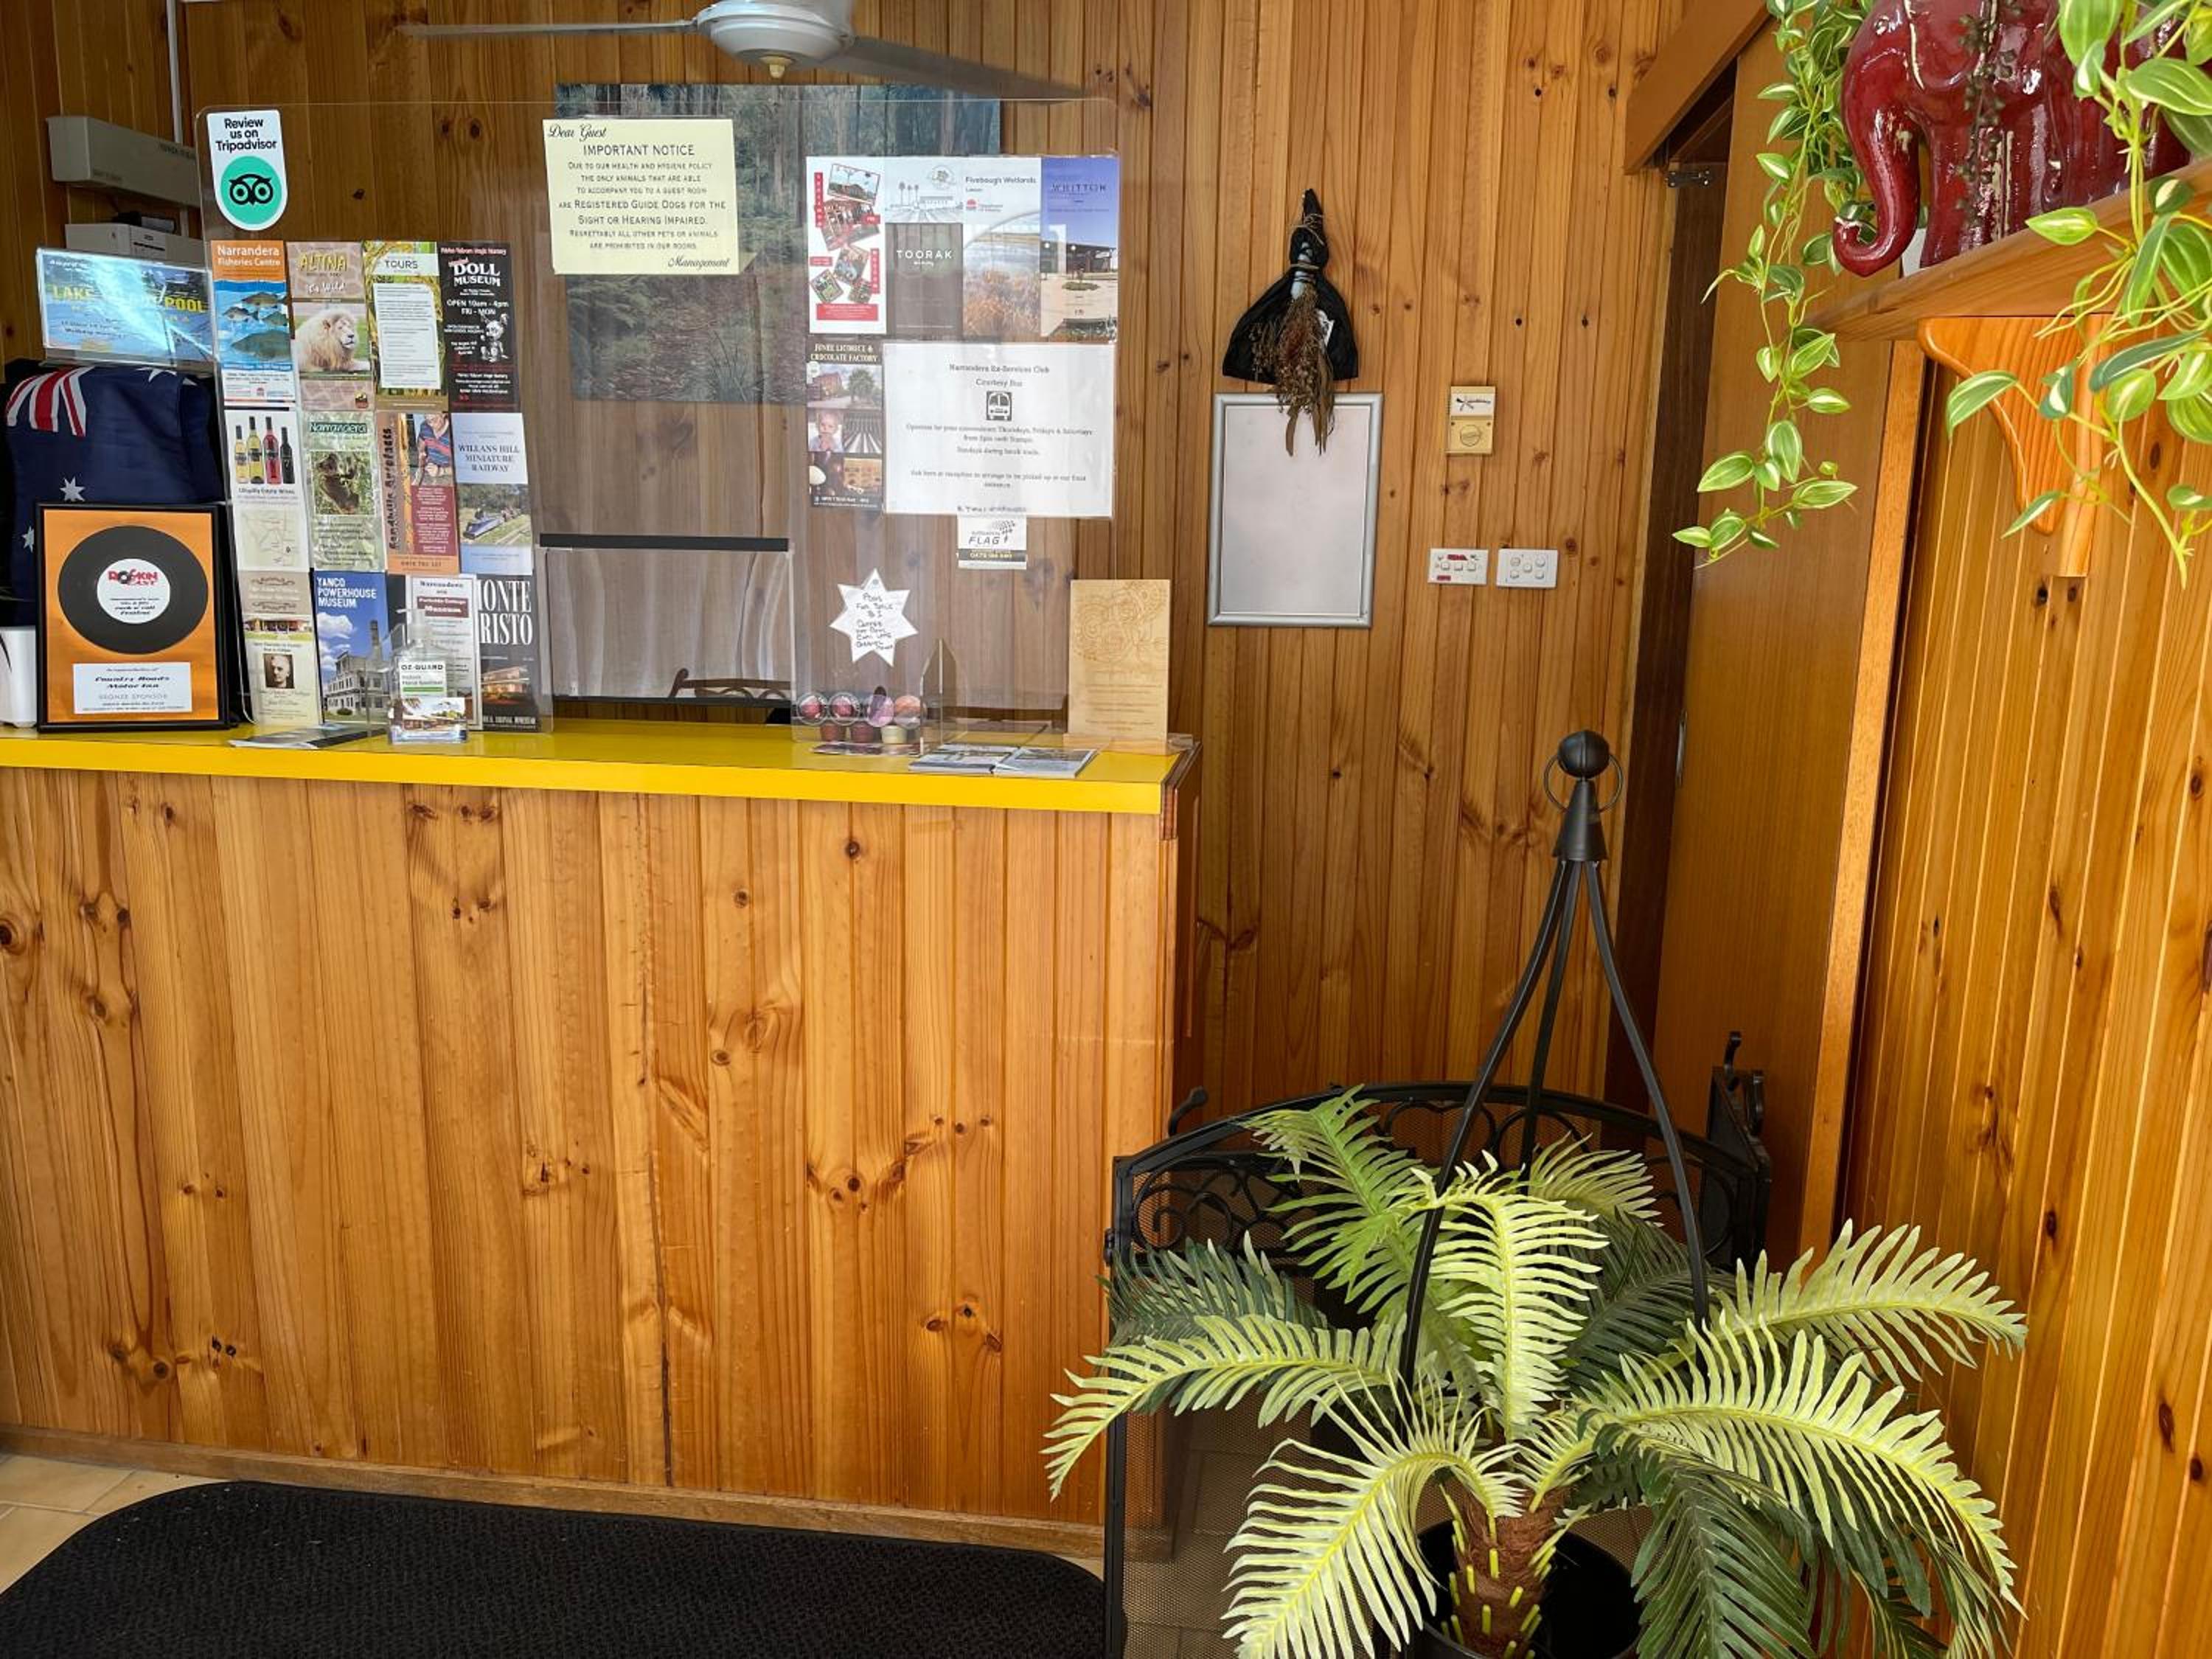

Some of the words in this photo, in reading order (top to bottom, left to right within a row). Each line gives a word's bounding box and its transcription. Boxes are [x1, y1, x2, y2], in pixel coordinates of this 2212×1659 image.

[224, 116, 263, 128] Review
[230, 131, 242, 139] us
[244, 129, 258, 138] on
[548, 125, 574, 138] Dear
[579, 124, 607, 142] Guest
[215, 139, 277, 153] Tripadvisor
[584, 145, 649, 156] IMPORTANT
[653, 145, 695, 156] NOTICE
[574, 200, 629, 209] REGISTERED
[631, 200, 658, 209] GUIDE
[661, 200, 686, 209] DOGS
[622, 215, 661, 225] HEARING
[218, 245, 279, 257] Narrandera
[897, 250, 953, 259] TOORAK
[218, 257, 253, 266] Fisheries
[254, 258, 281, 266] Centre
[300, 251, 347, 271] ALTINA
[385, 260, 418, 269] TOURS
[667, 255, 730, 271] Management
[453, 262, 501, 276] DOLL
[453, 275, 501, 287] MUSEUM
[52, 284, 91, 301] LAKE
[164, 296, 206, 313] POOL
[446, 299, 467, 307] OPEN
[468, 299, 487, 307] 10am
[478, 307, 496, 316] MON
[810, 353, 848, 361] CHOCOLATE
[849, 354, 878, 362] FACTORY
[975, 378, 1008, 388] Courtesy
[310, 422, 367, 433] Narrandera
[458, 444, 497, 452] WILLANS
[499, 445, 520, 453] HILL
[465, 454, 514, 462] MINIATURE
[472, 464, 509, 472] RAILWAY
[968, 536, 1001, 545] FLAG
[316, 577, 346, 587] YANCO
[317, 588, 378, 599] POWERHOUSE
[317, 598, 357, 608] MUSEUM
[480, 613, 533, 645] RISTO
